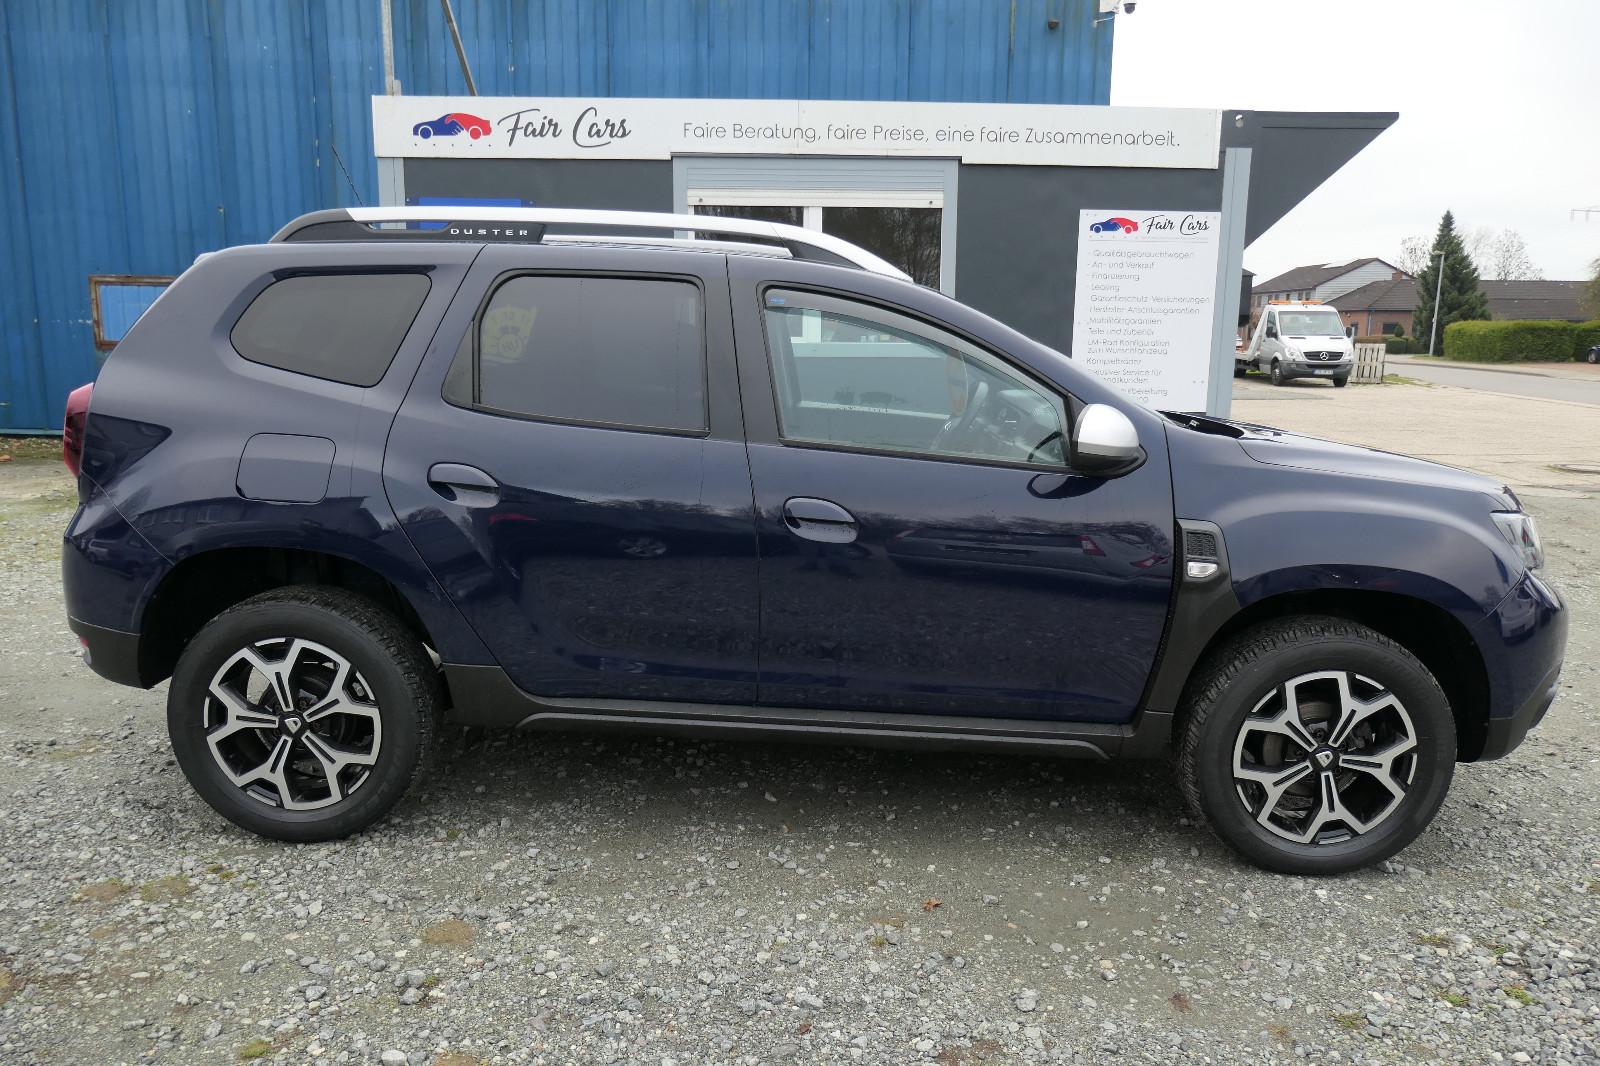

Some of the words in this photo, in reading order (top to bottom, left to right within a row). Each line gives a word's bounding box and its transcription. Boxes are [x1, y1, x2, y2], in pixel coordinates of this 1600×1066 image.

[497, 108, 563, 147] Fair
[572, 106, 632, 148] Cars
[683, 123, 727, 139] Faire
[733, 123, 822, 143] Beratung,
[827, 124, 867, 140] faire
[873, 125, 928, 143] Preise,
[935, 126, 975, 142] eine
[979, 125, 1020, 142] faire
[1025, 127, 1181, 147] Zusammenarbeit.
[450, 228, 528, 236] DUSTER
[1142, 214, 1175, 235] Fair
[1179, 214, 1210, 236] Cars
[1108, 261, 1124, 269] und
